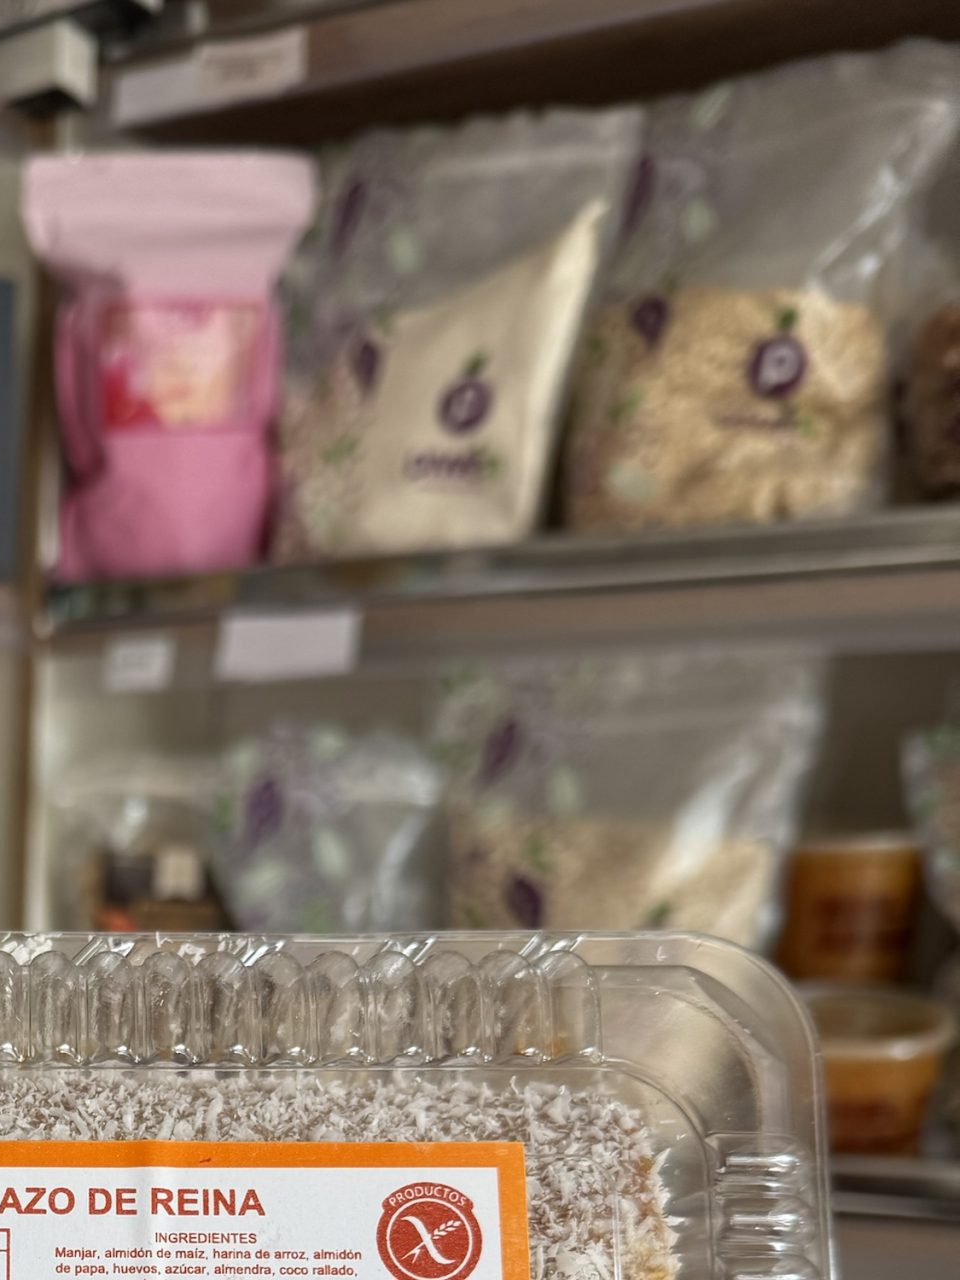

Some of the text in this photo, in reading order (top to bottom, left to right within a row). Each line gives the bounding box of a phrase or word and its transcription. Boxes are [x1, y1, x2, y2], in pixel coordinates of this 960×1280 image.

[88, 1188, 137, 1215] DE
[151, 1187, 265, 1216] REINA
[388, 1186, 467, 1207] PRODUCTOS
[155, 1232, 257, 1244] INGREDIENTES
[55, 1247, 362, 1261] Manjar, almidón de maíz, harina de arroz, almidón
[56, 1263, 357, 1277] de papa, huevos, azúcar, almendra, coco rallado,
